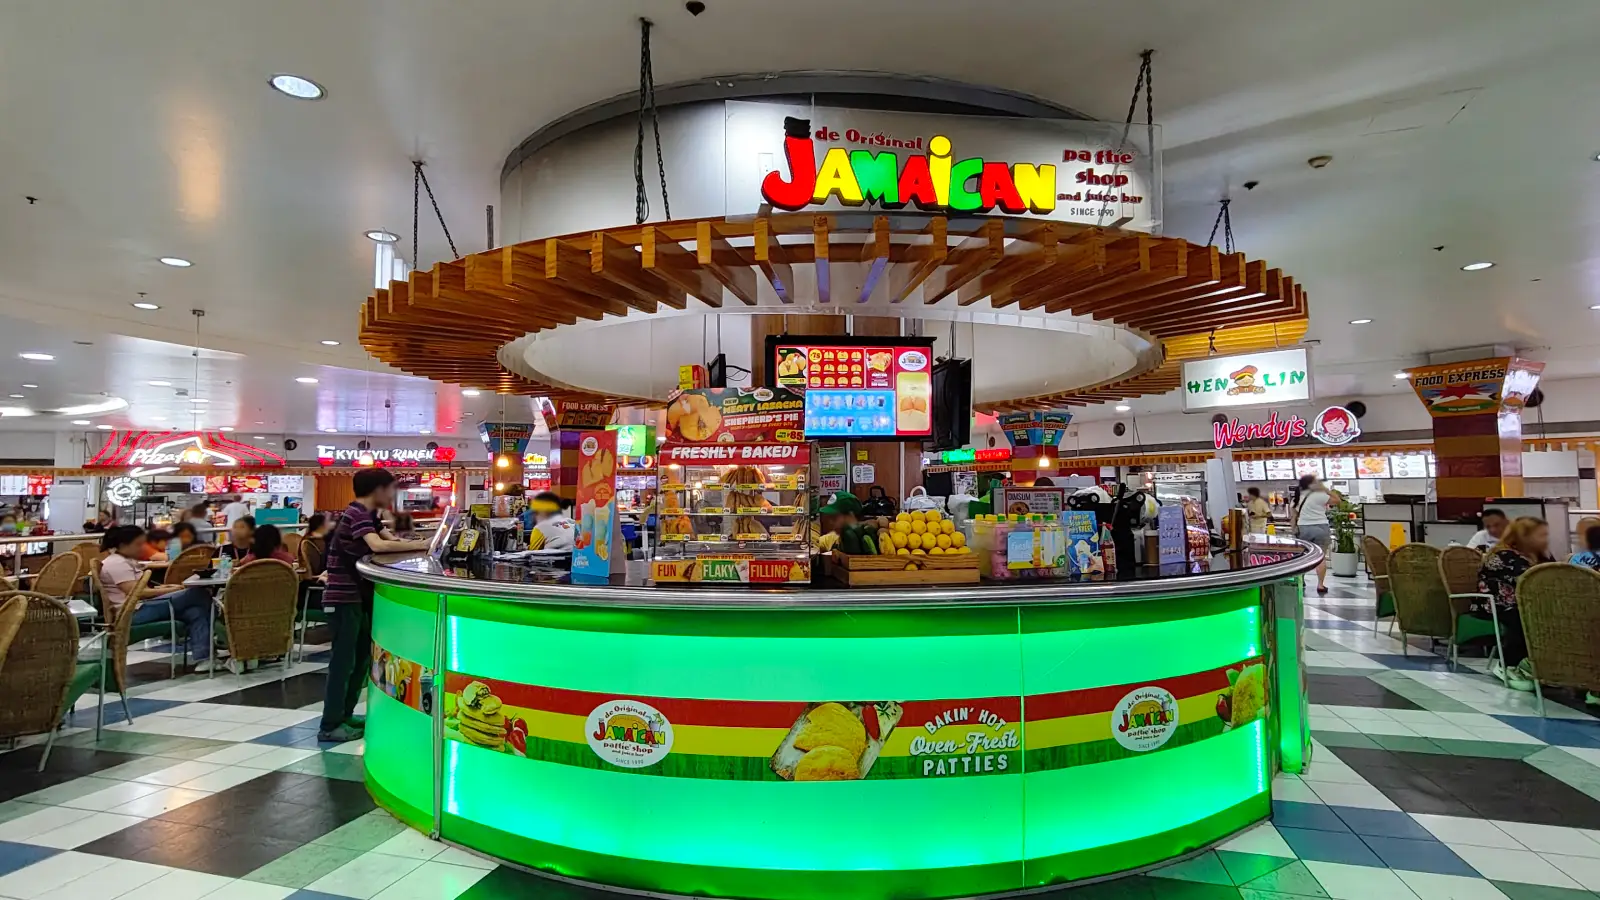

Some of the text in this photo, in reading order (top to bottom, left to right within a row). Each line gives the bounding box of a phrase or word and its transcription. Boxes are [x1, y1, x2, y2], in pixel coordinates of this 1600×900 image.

[815, 127, 923, 150] de Original
[1075, 168, 1129, 188] shop
[1057, 189, 1144, 203] and juice bar
[1070, 207, 1096, 217] SINCE
[1187, 370, 1305, 394] HEN LIN
[1415, 368, 1505, 387] FOOD EXPRESS
[562, 402, 609, 412] FOOD EXPRESS
[724, 413, 783, 428] SHEPHERD'S
[784, 413, 799, 422] PIE
[1213, 411, 1306, 450] Wendy's
[391, 449, 436, 462] RAMEN
[671, 445, 798, 460] FRESHLY BAKED!
[1008, 493, 1031, 501] DIMSUM
[657, 564, 677, 577] FUN
[703, 564, 734, 578] FLAKY
[751, 564, 789, 578] FILLING
[614, 705, 647, 717] Original
[924, 707, 1007, 735] BAKIN' HOT
[603, 742, 653, 754] pattie shop
[909, 729, 1020, 756] Oven-Fresh
[923, 754, 1008, 776] PATTIES
